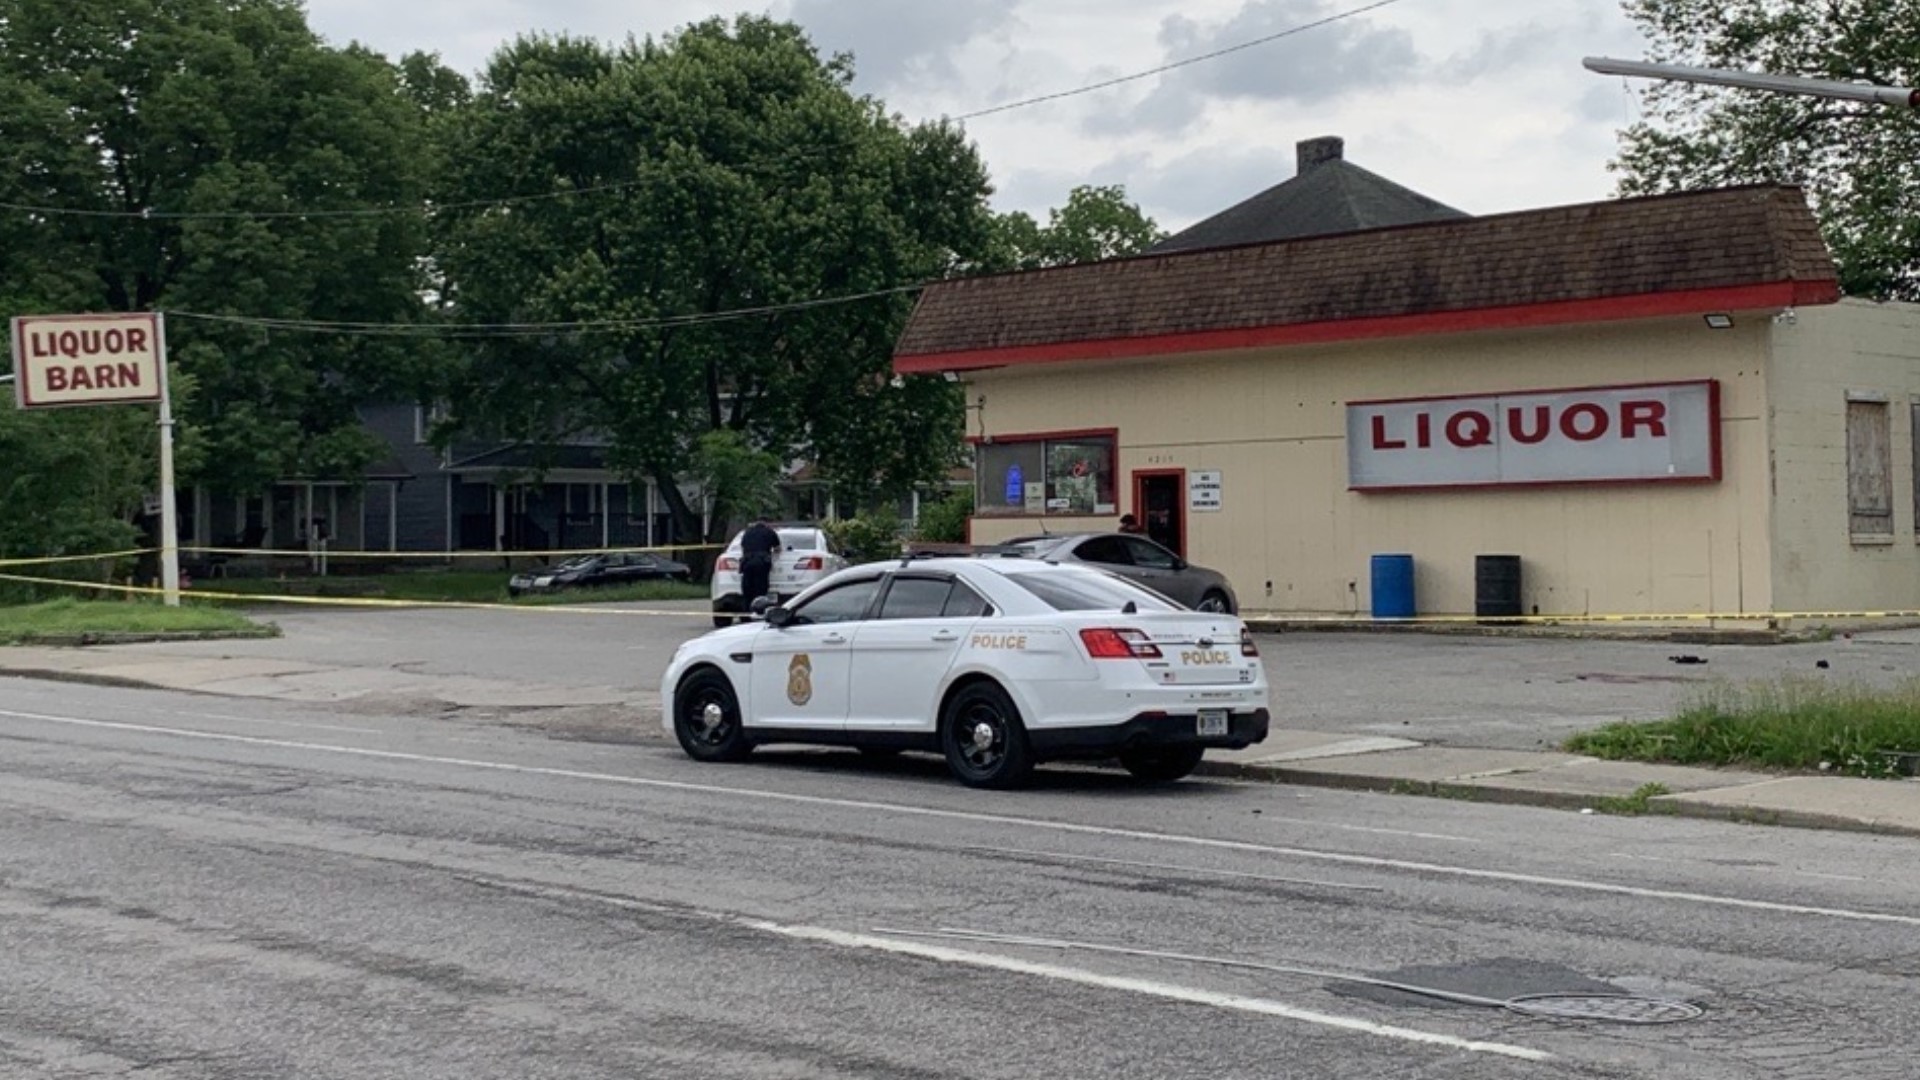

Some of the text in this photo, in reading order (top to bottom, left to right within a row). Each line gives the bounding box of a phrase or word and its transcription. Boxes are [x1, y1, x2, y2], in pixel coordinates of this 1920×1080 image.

[31, 328, 148, 358] LIQUOR
[46, 362, 140, 392] BARN
[1372, 400, 1667, 450] LIQUOR
[970, 634, 1027, 649] POLICE
[1181, 651, 1231, 665] POLICE
